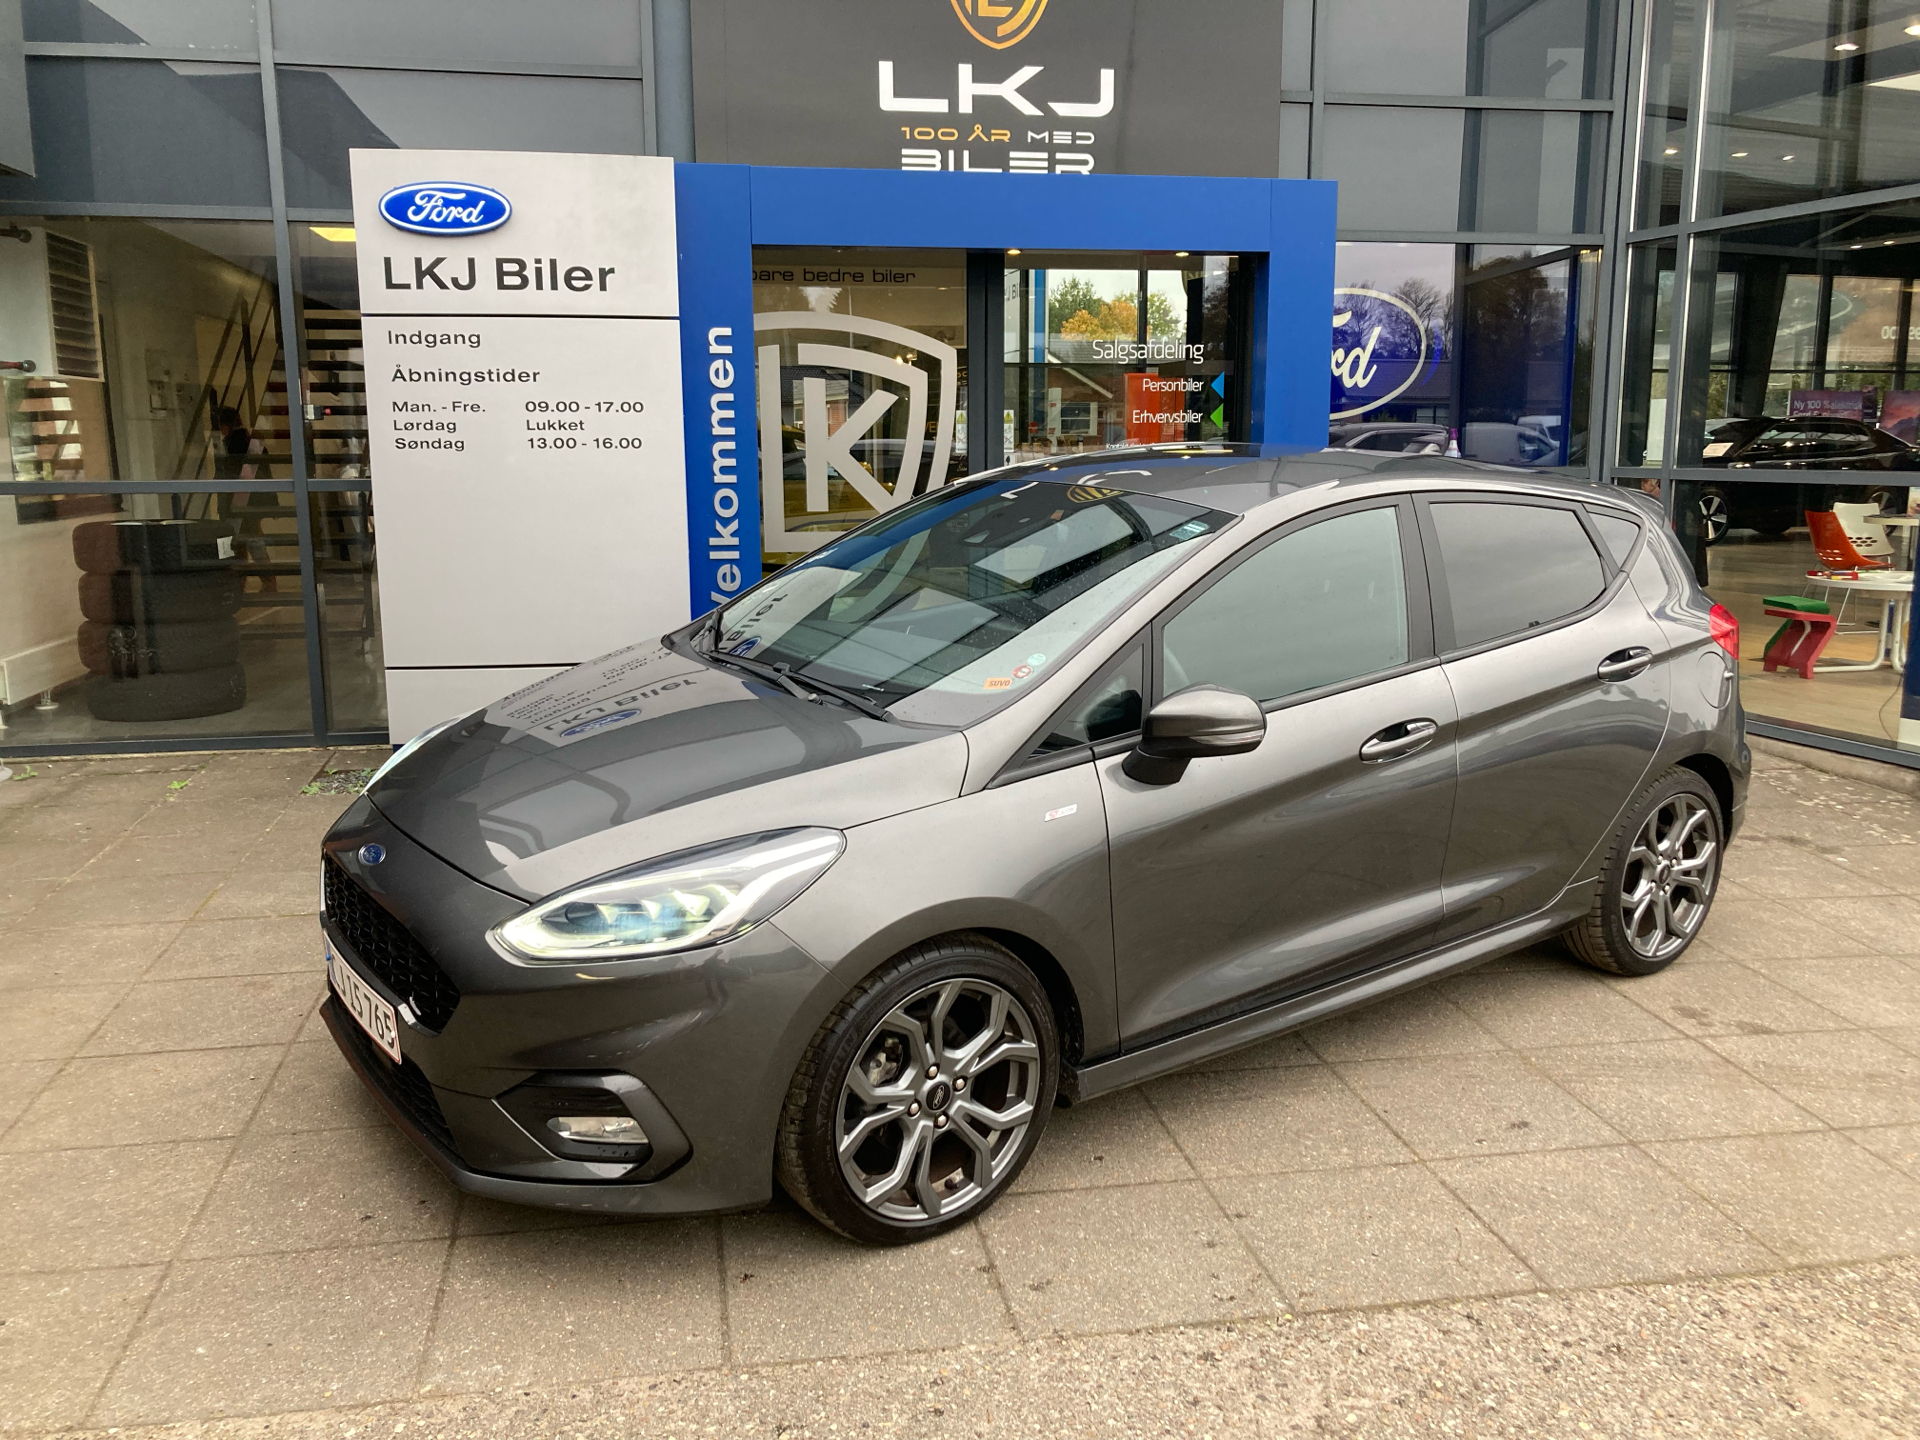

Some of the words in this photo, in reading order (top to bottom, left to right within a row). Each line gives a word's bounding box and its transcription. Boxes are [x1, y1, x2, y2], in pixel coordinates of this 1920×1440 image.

[878, 60, 1115, 118] LKJ
[901, 126, 958, 141] 100
[967, 123, 1011, 143] ÅR
[1027, 130, 1095, 145] MED
[901, 148, 1095, 175] BILER
[407, 190, 485, 223] Ford
[383, 256, 477, 291] LKJ
[495, 257, 615, 292] Biler
[803, 268, 865, 283] bedre
[872, 269, 916, 283] biler
[388, 330, 481, 348] Indgang
[1092, 338, 1205, 364] Salgsafdeling
[391, 364, 541, 386] Åbningstider
[1142, 377, 1205, 392] Personbiler
[392, 401, 437, 413] Man.
[451, 400, 486, 413] Fre.
[525, 401, 580, 413] 09.00
[594, 401, 644, 413] 17.00
[1132, 409, 1204, 424] Erhvervsbiler
[393, 419, 457, 433] Lørdag
[526, 419, 585, 431] Lukket
[394, 437, 465, 451] Søndag
[527, 437, 577, 450] 13.00
[592, 437, 643, 450] 16.00
